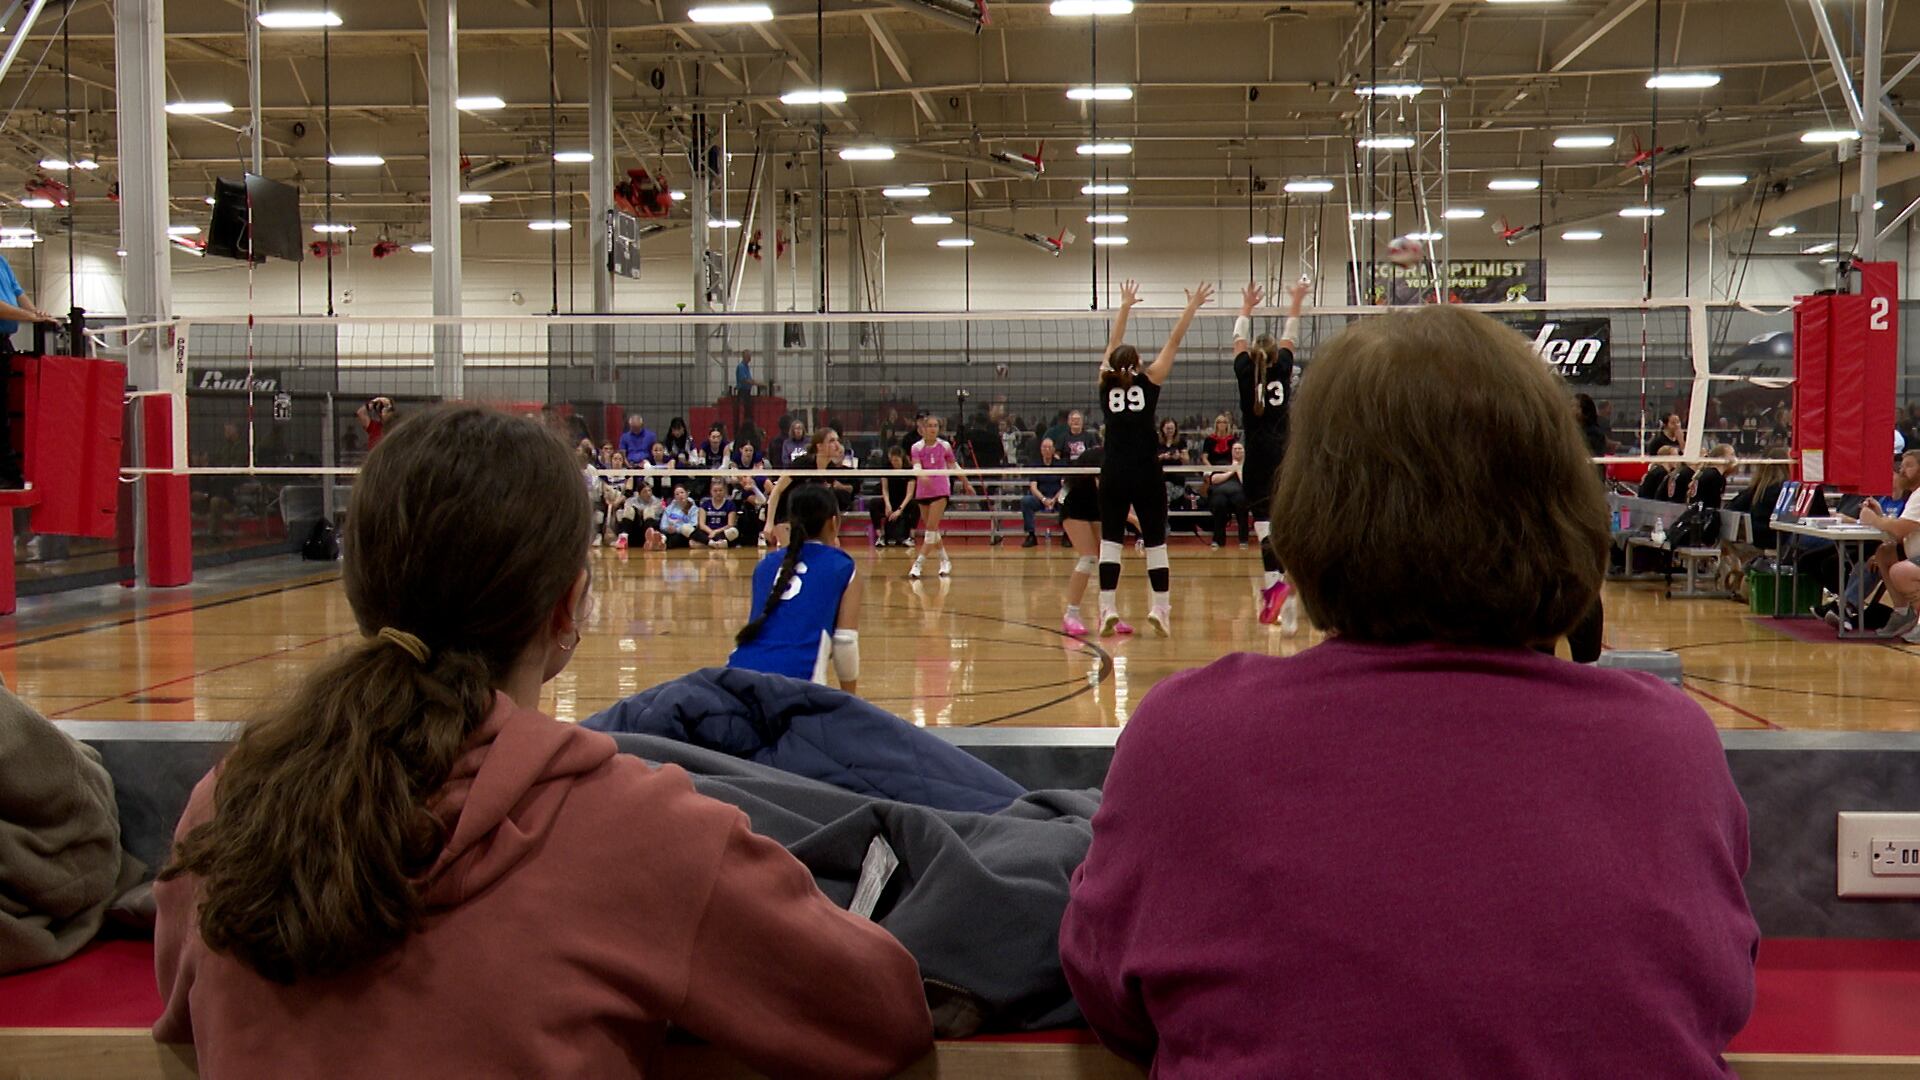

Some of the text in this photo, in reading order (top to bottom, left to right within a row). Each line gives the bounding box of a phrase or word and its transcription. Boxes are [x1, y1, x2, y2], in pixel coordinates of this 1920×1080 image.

[1870, 296, 1889, 330] 2
[200, 371, 277, 390] Baden
[1108, 385, 1146, 413] 89
